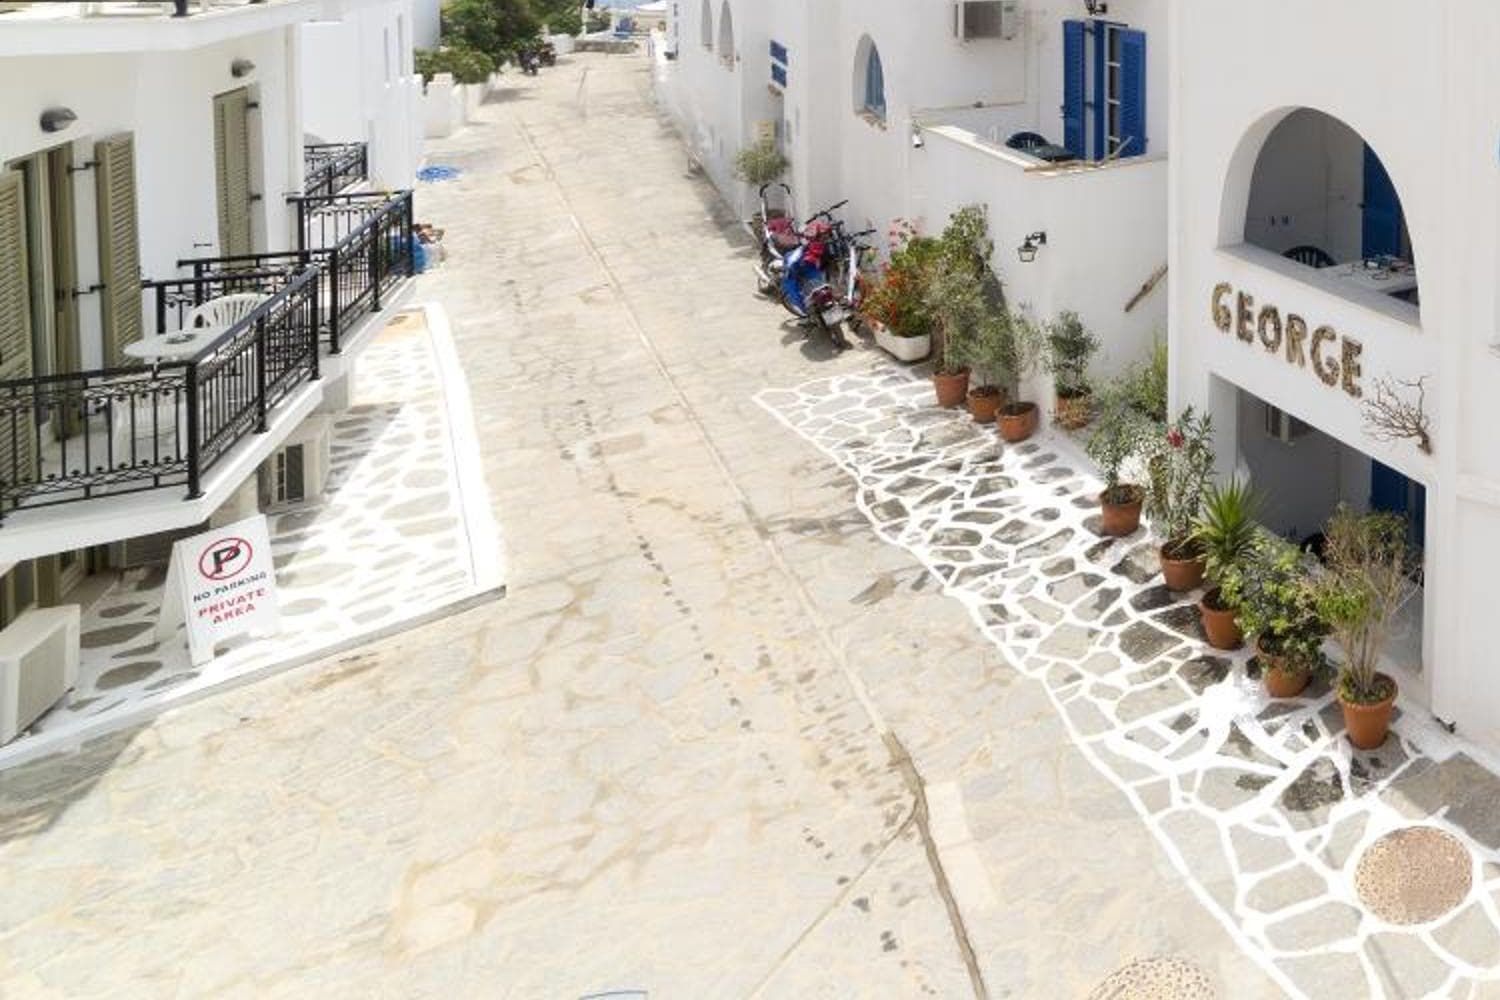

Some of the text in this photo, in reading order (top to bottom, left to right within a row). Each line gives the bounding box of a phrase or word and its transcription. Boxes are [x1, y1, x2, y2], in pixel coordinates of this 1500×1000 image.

[1211, 282, 1364, 399] GEORGE
[193, 571, 267, 603] NO PARKING
[199, 587, 265, 617] PRIVATE
[213, 603, 256, 624] AREA
